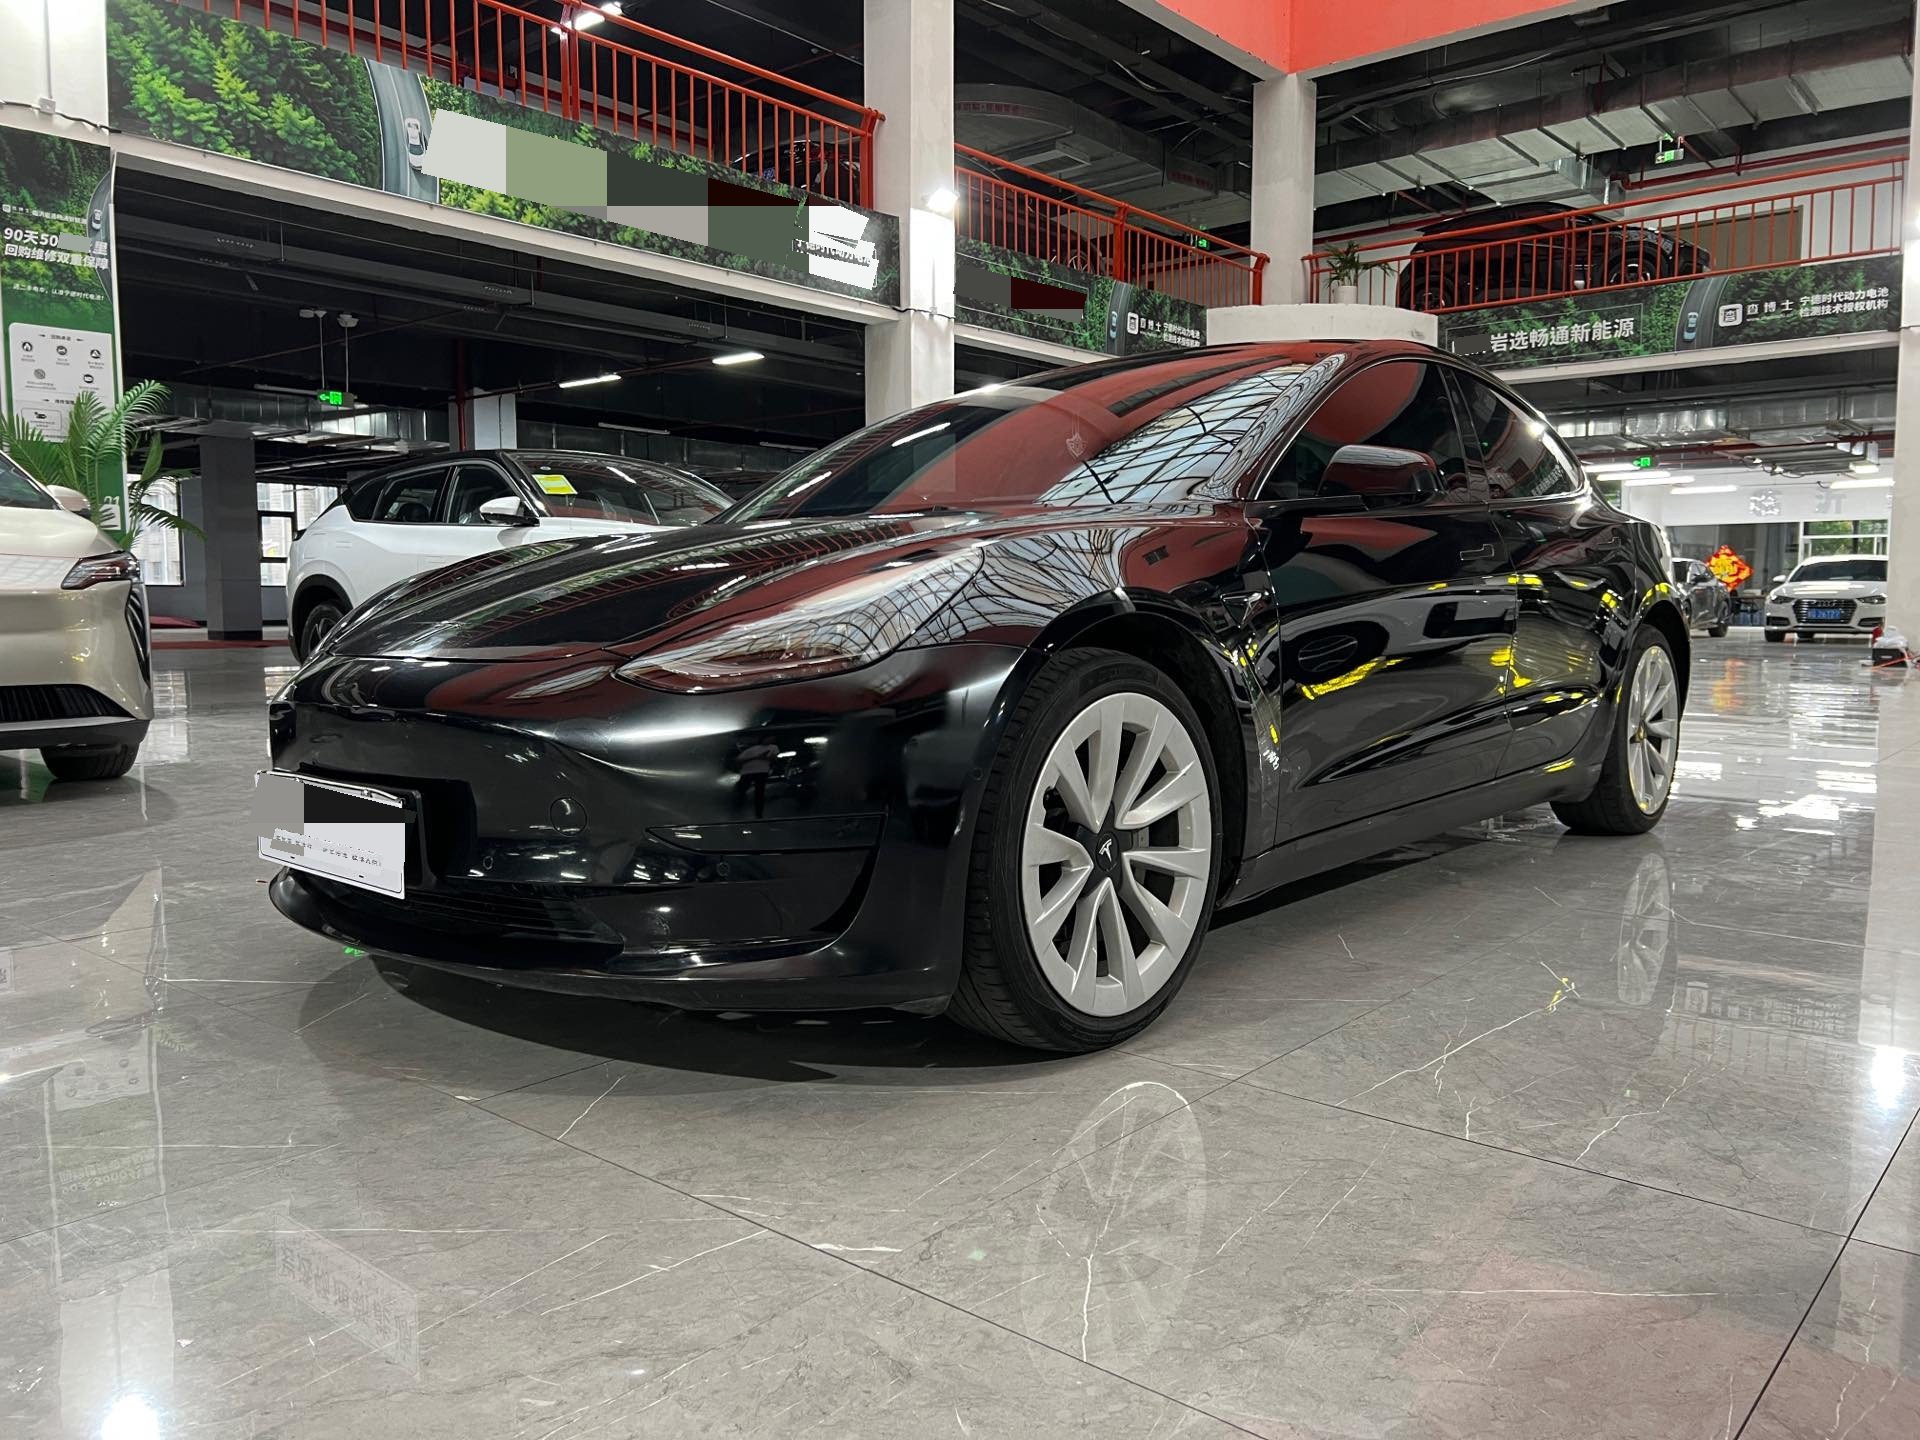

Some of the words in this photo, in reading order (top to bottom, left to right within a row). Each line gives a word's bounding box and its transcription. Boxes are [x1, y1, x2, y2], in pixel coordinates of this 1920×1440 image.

[4, 227, 108, 256] 90天50里
[5, 243, 109, 270] 回购维修双重保障
[1800, 287, 1889, 307] 宁德时代动力电池
[1800, 299, 1889, 319] 检测技术授权机构
[1452, 317, 1635, 357] 岩选畅通新能源
